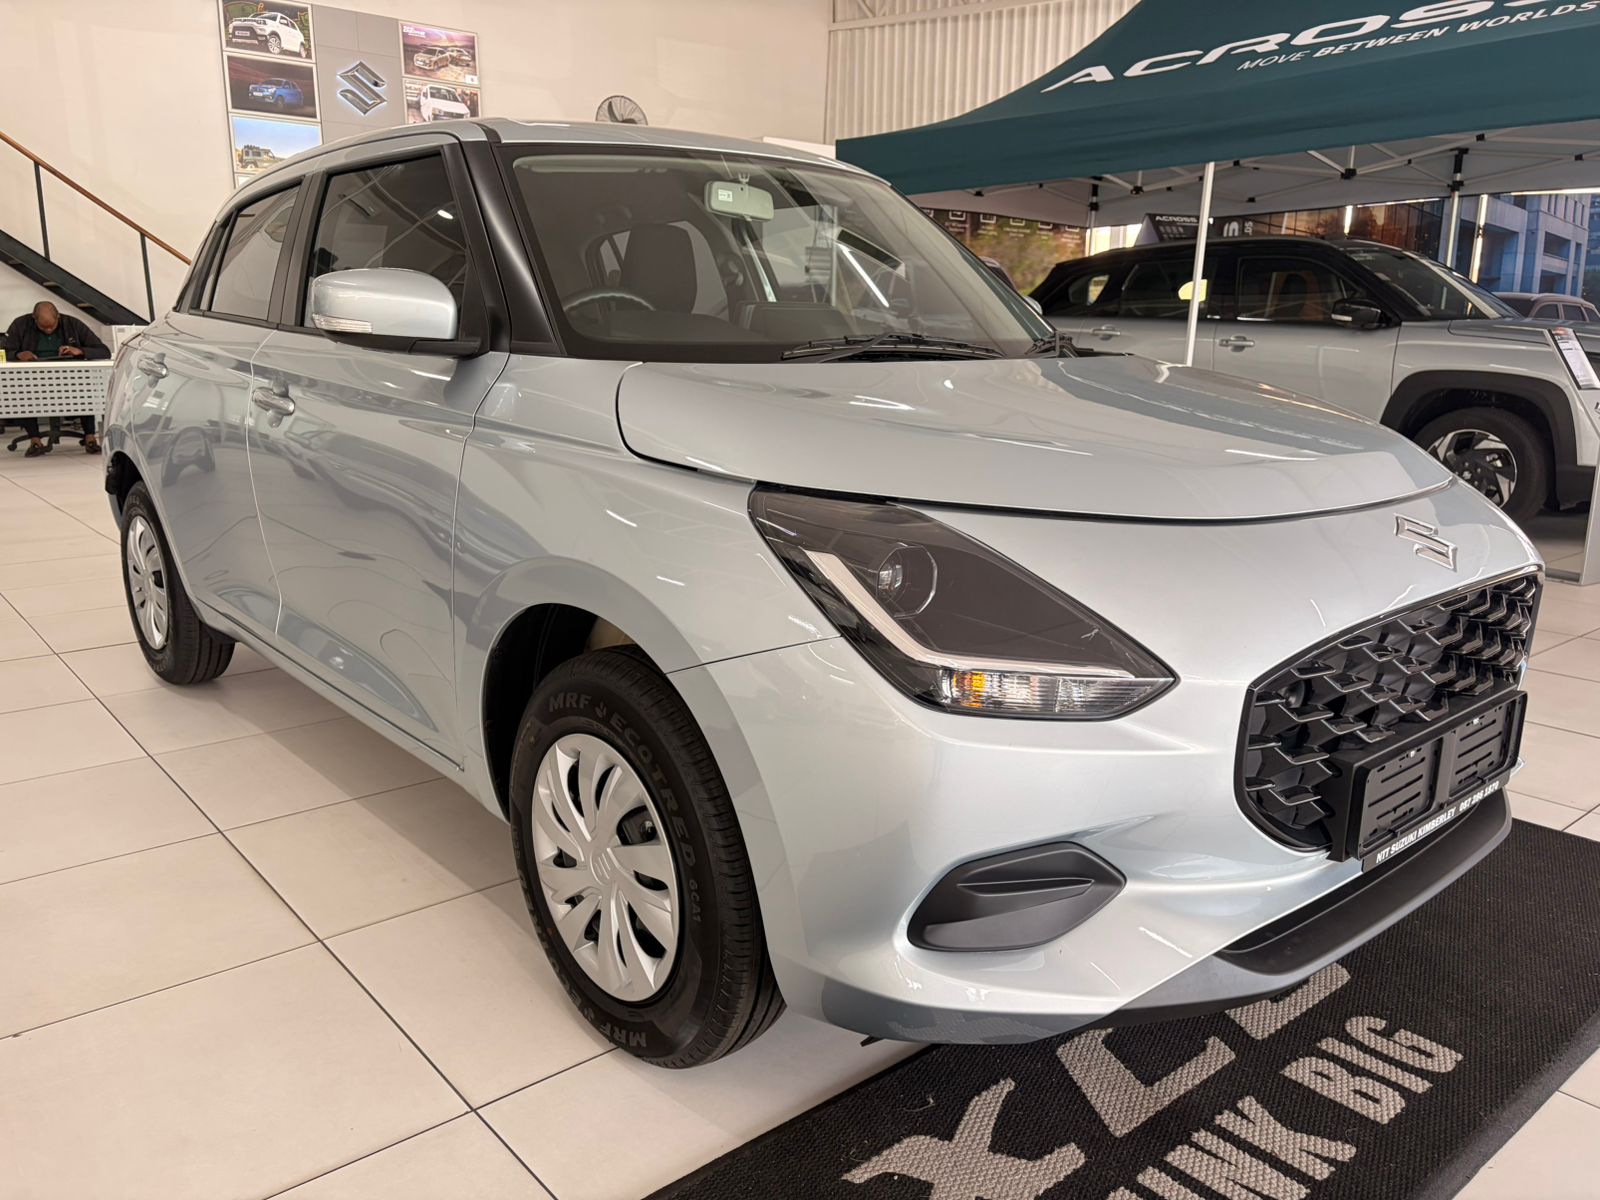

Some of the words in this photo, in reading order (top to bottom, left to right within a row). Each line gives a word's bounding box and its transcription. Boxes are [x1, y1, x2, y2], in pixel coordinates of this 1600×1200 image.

[1040, 0, 1547, 93] ACROS
[1237, 50, 1310, 71] MOVE
[1312, 26, 1450, 58] BETWEEN
[1457, 0, 1600, 33] WORLDS
[1155, 215, 1198, 223] ACROSS
[550, 692, 592, 713] MRF
[611, 712, 696, 868] ECOTRED
[1376, 847, 1391, 863] NTT
[1390, 830, 1418, 854] SUZUKI
[1417, 807, 1456, 837] KIMBERLEY
[600, 1024, 647, 1048] MRF
[1279, 1015, 1464, 1125] BIG
